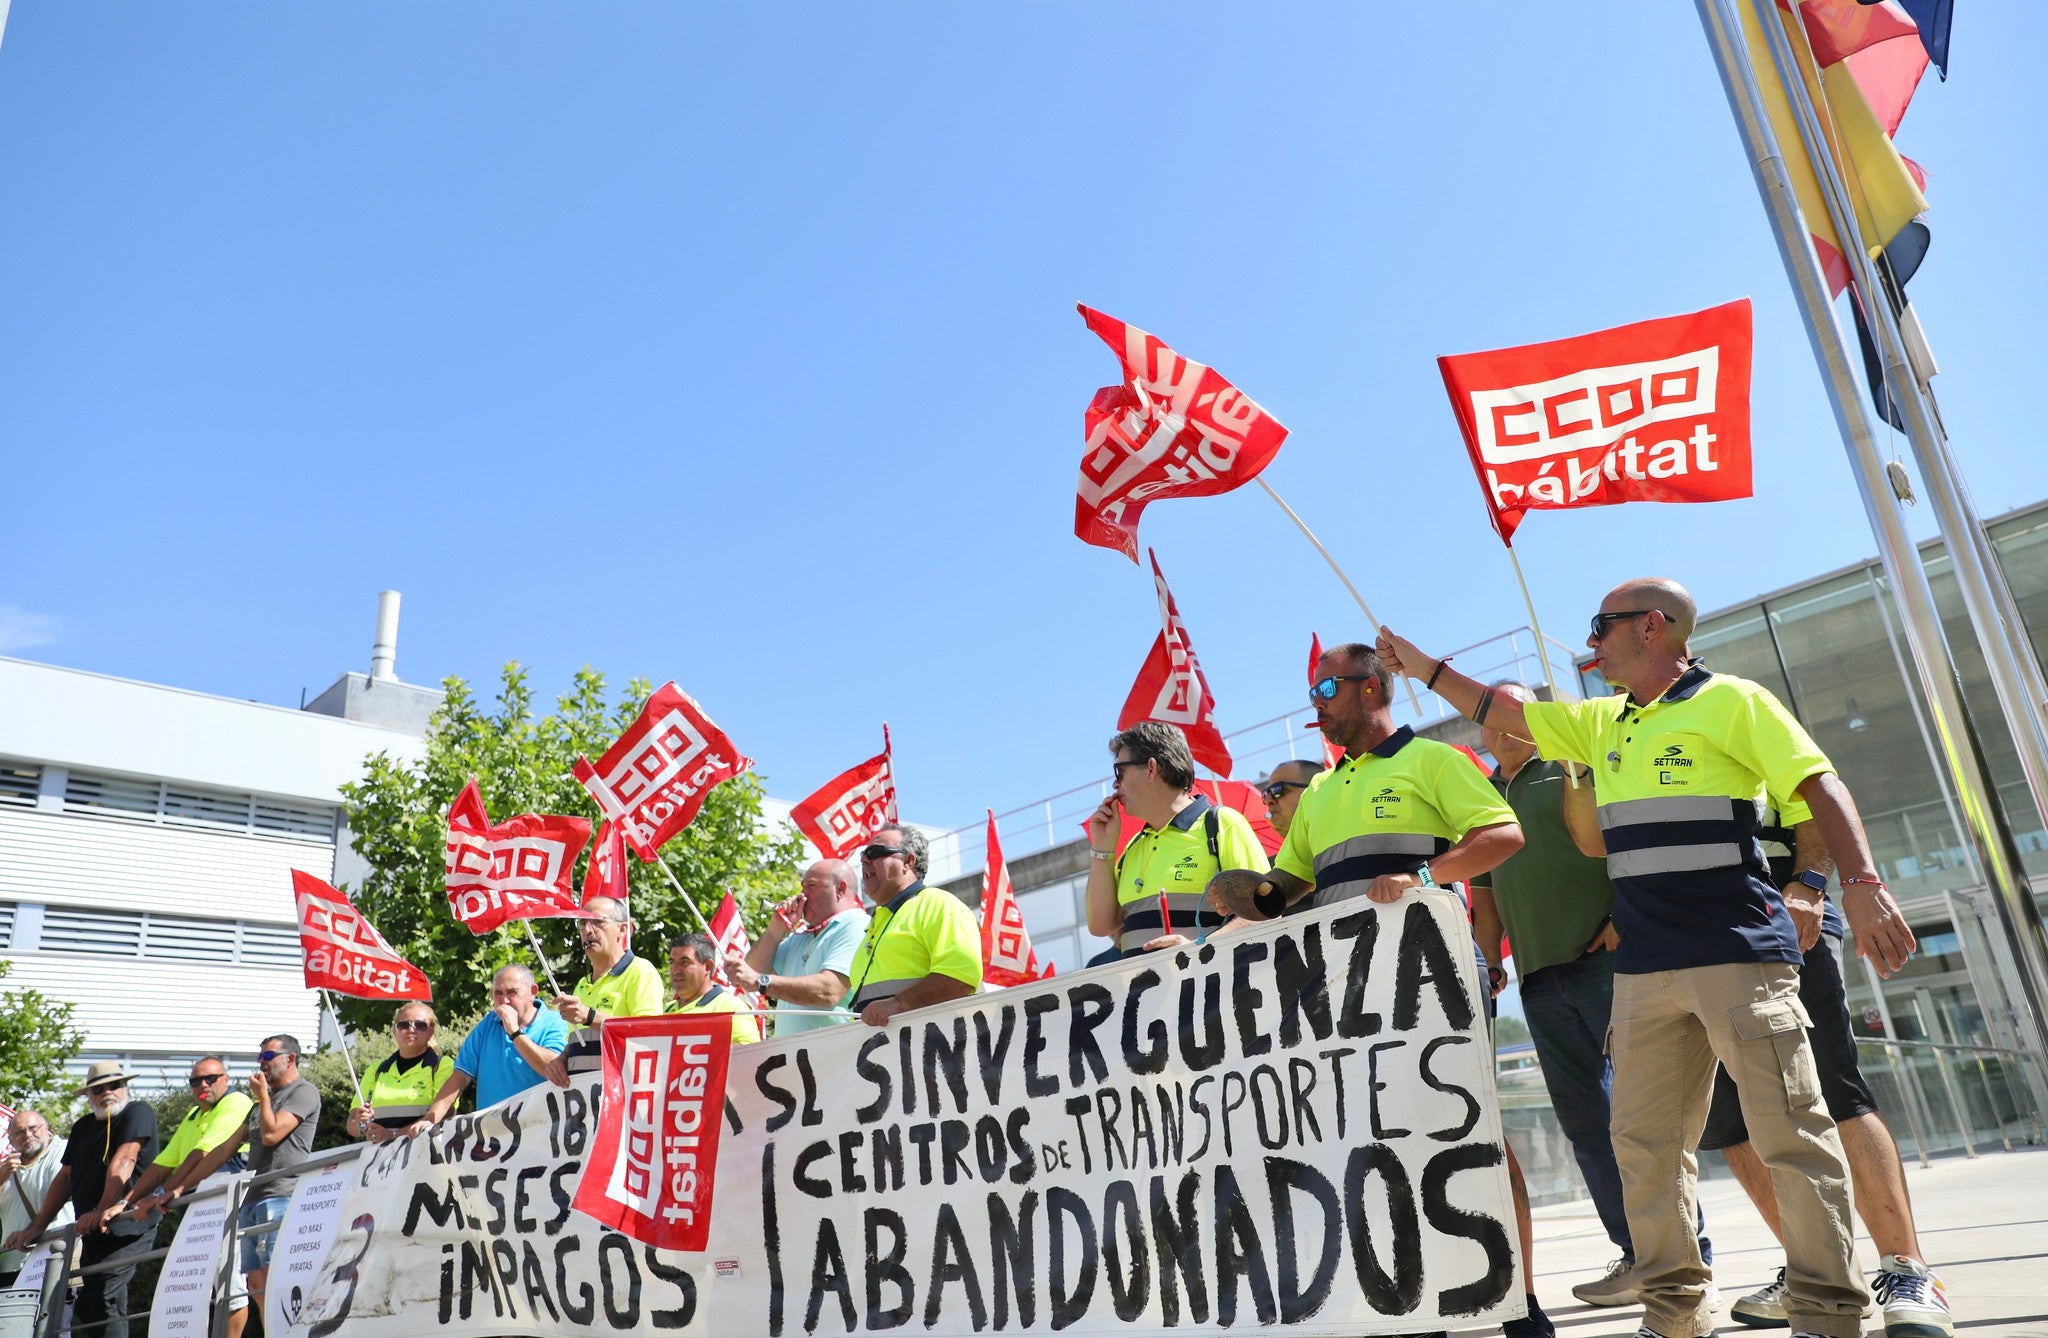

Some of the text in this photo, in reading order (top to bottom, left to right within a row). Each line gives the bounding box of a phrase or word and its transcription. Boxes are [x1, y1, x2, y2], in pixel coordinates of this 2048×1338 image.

[1490, 366, 1700, 447] CCOO
[1486, 423, 1718, 510] hábitat
[1654, 758, 1692, 767] SETTRAN
[302, 945, 411, 994] ábitat
[754, 1048, 823, 1133] SL
[856, 902, 1475, 1125] SINVERGÜENZA
[793, 1035, 1482, 1198] CENTROS DE TRANSPORTES
[306, 1181, 343, 1196] CENTROS DE
[299, 1199, 337, 1213] TRANSPORTE
[401, 1161, 581, 1237] MESES
[298, 1224, 308, 1235] NO
[803, 1141, 1517, 1336] ABANDONADOS
[290, 1241, 321, 1254] EMPRESAS
[289, 1261, 313, 1272] PIRATAS
[165, 1283, 198, 1293] EXTREMADURA
[166, 1305, 193, 1315] LA EMPRESA
